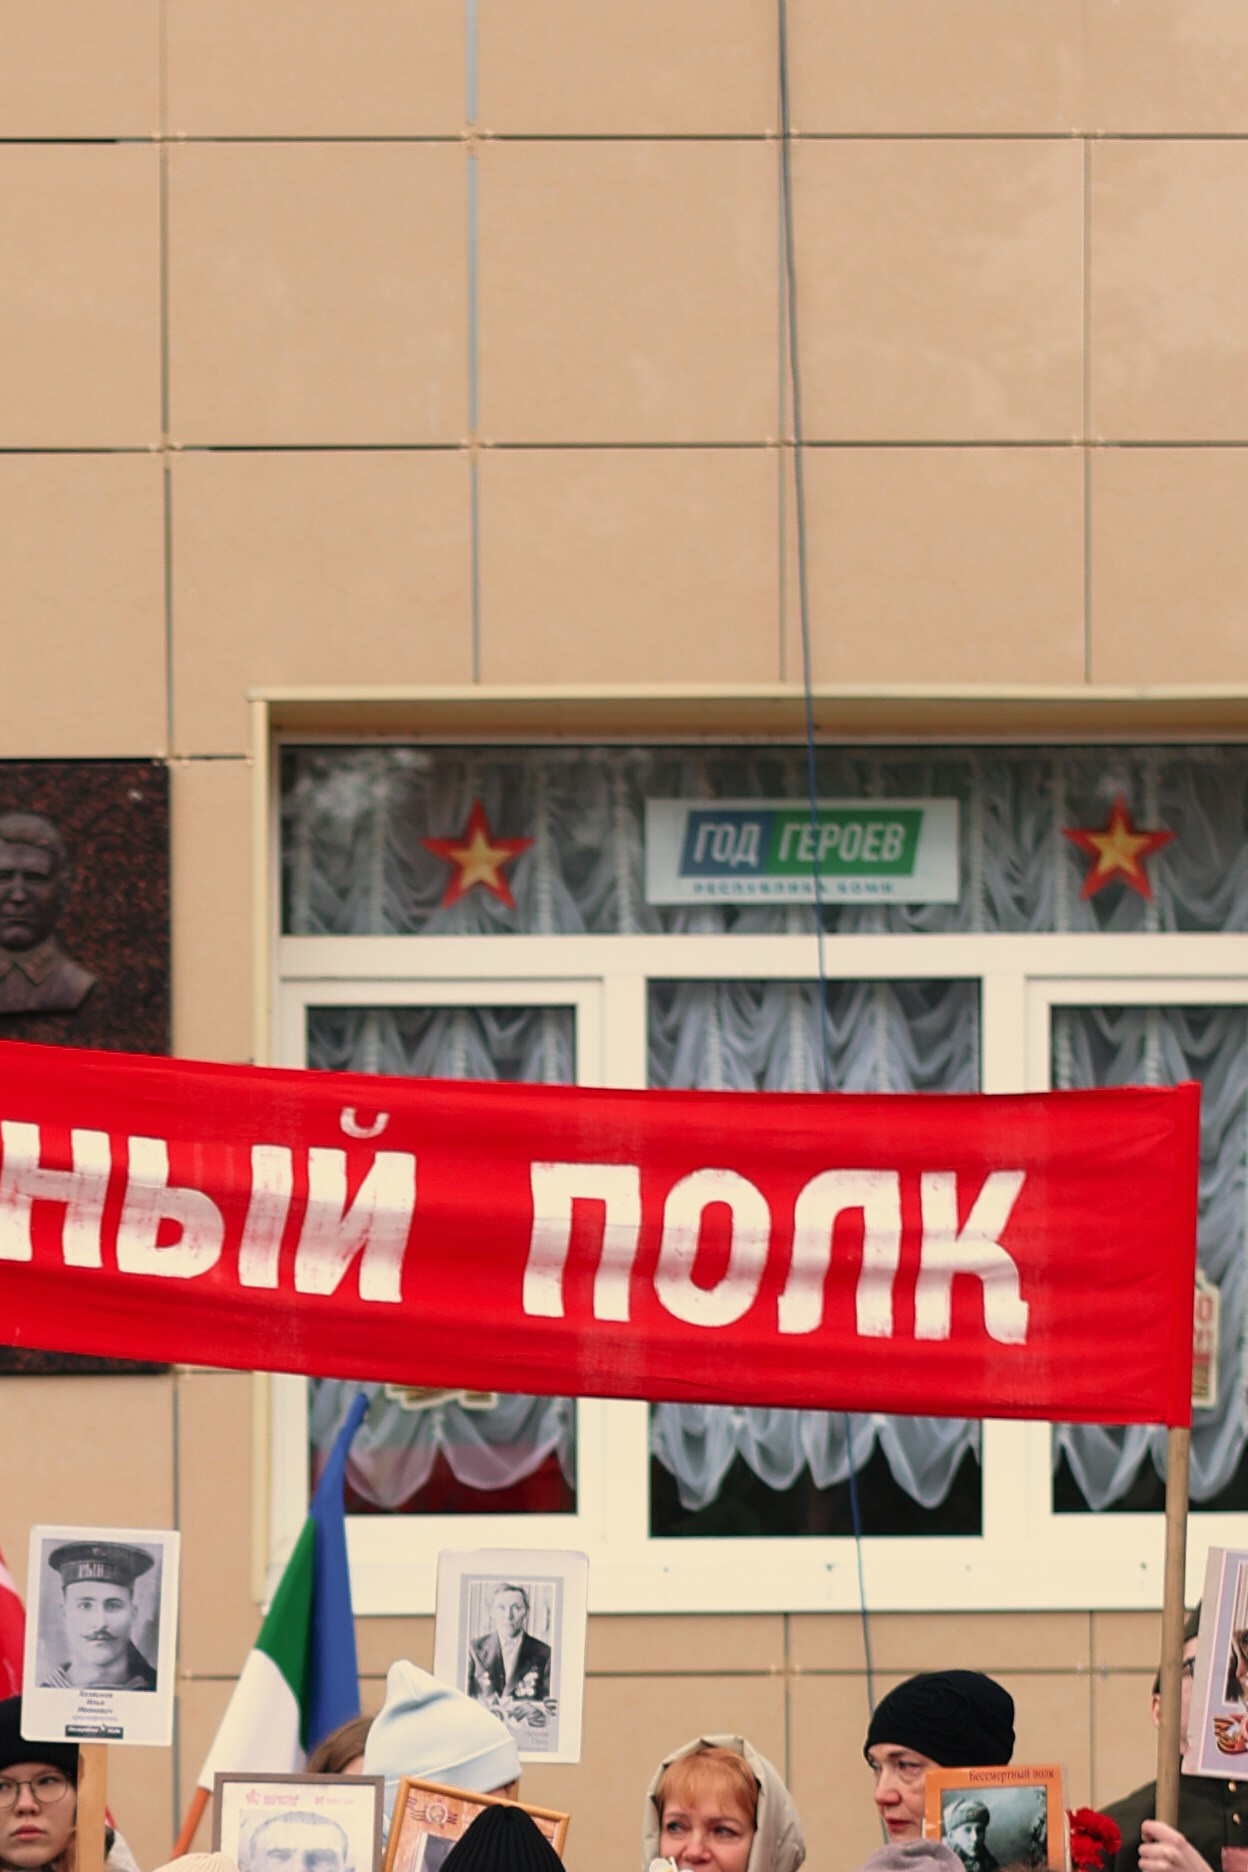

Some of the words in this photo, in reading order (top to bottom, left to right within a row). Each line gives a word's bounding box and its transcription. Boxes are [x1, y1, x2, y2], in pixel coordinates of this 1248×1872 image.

[693, 821, 762, 868] ГОД
[777, 821, 906, 864] ГЕРОЕВ
[523, 1161, 1029, 1345] ПОЛК
[969, 1769, 1030, 1782] Бессмертный
[1033, 1770, 1054, 1779] полк
